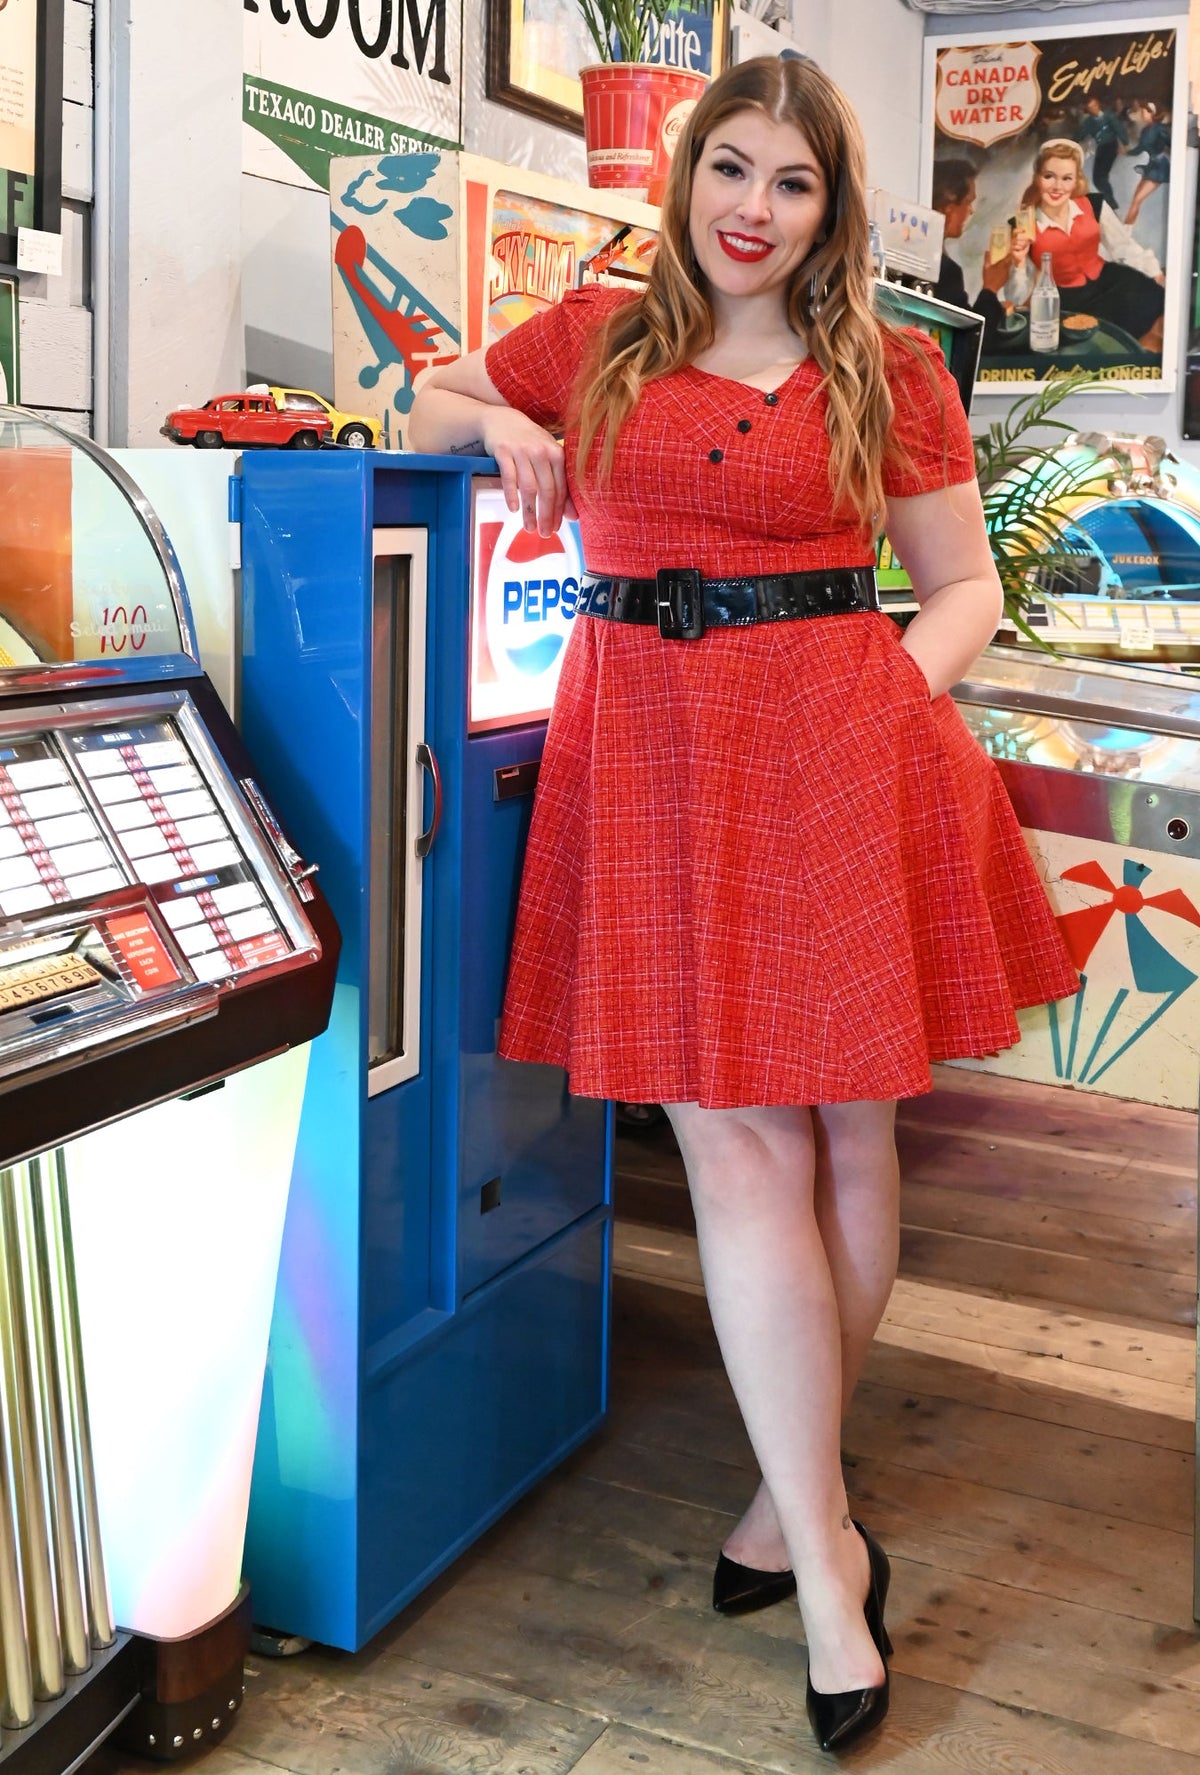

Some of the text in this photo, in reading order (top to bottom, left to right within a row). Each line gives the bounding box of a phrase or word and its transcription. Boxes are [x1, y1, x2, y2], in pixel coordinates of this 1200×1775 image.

[633, 12, 702, 71] prite
[946, 65, 1030, 87] CANADA
[1048, 28, 1176, 102] Enjoy Life!
[949, 105, 1024, 125] WATER
[967, 86, 1008, 105] DRY
[245, 84, 448, 154] TEXACO DEALER SERV
[889, 207, 929, 238] LYON
[489, 231, 532, 305] SKY
[980, 368, 1036, 382] DRINKS
[1100, 366, 1162, 381] LONGER
[1113, 555, 1160, 565] JUKEBOX
[503, 577, 583, 625] PEPS
[100, 605, 147, 653] 100
